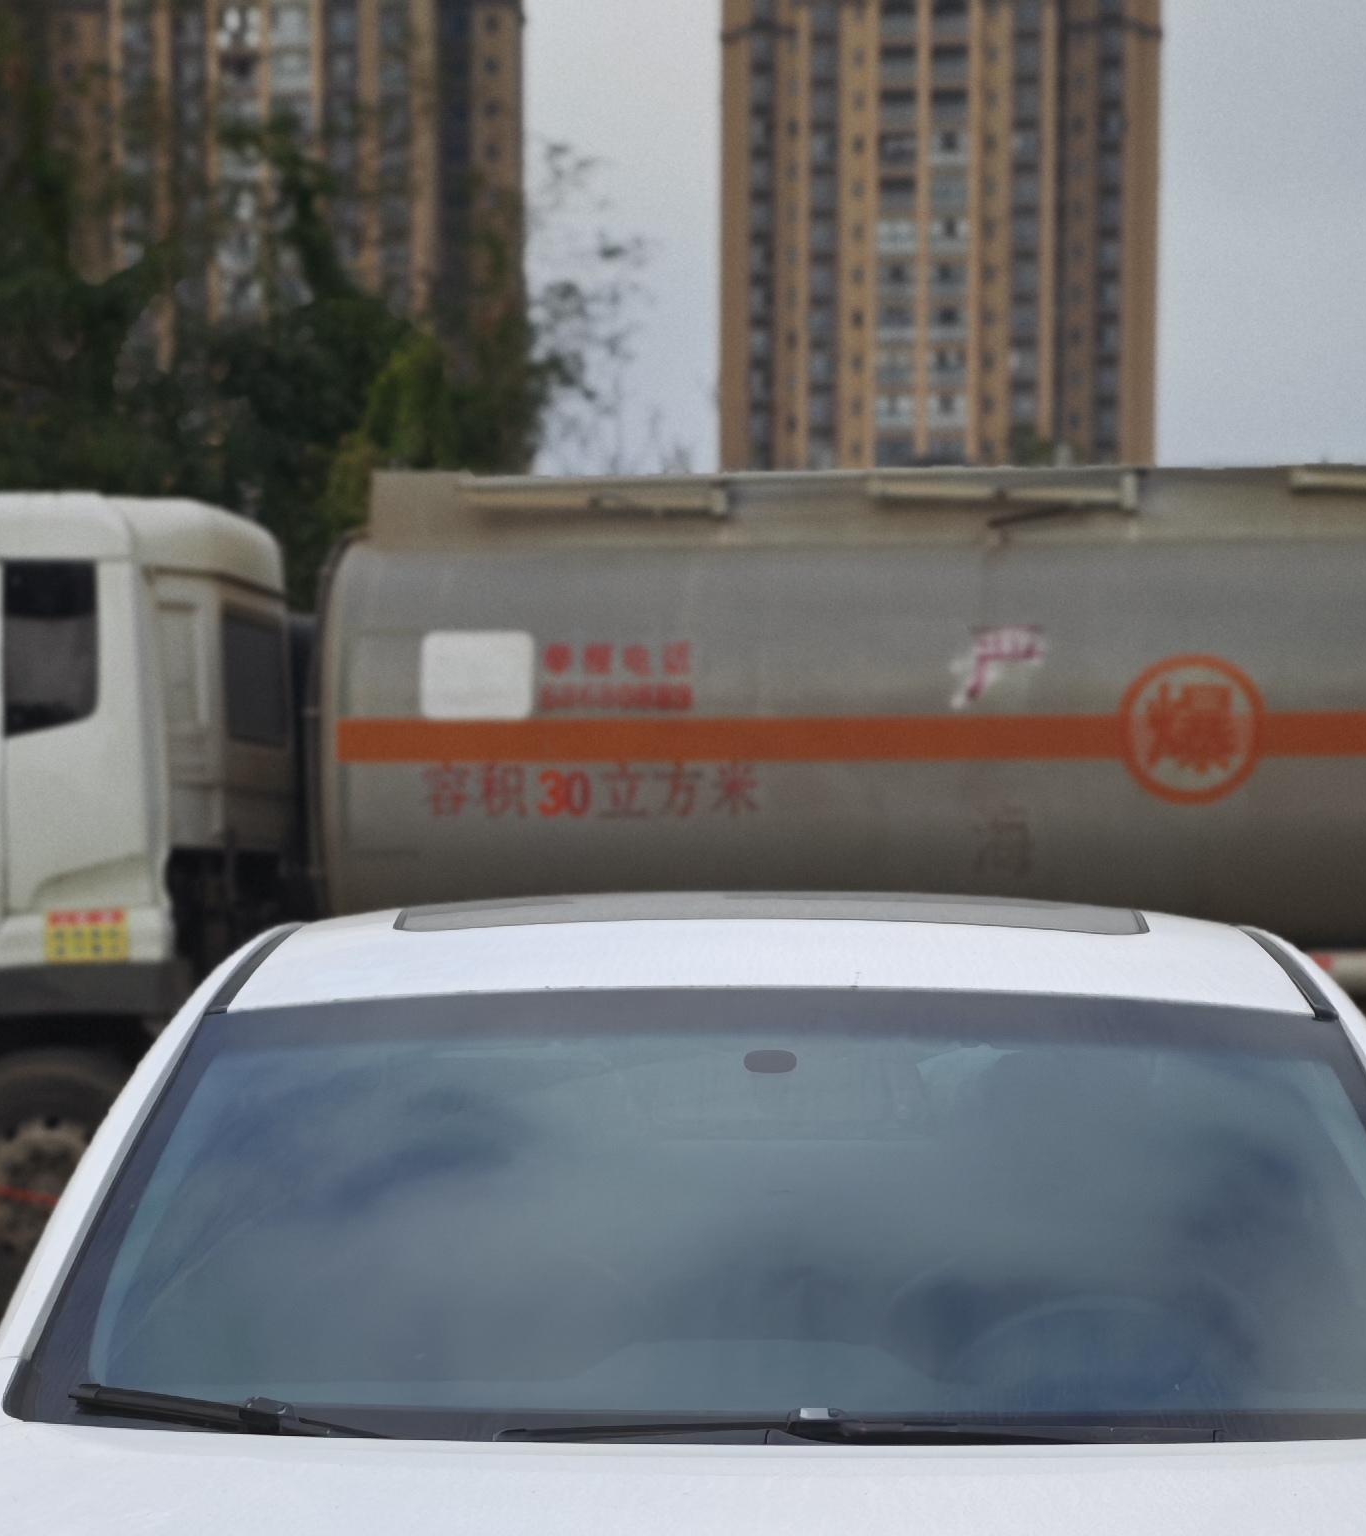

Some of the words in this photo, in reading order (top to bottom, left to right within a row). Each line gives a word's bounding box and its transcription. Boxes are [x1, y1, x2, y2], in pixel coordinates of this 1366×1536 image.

[420, 757, 760, 820] 容积30立方米
